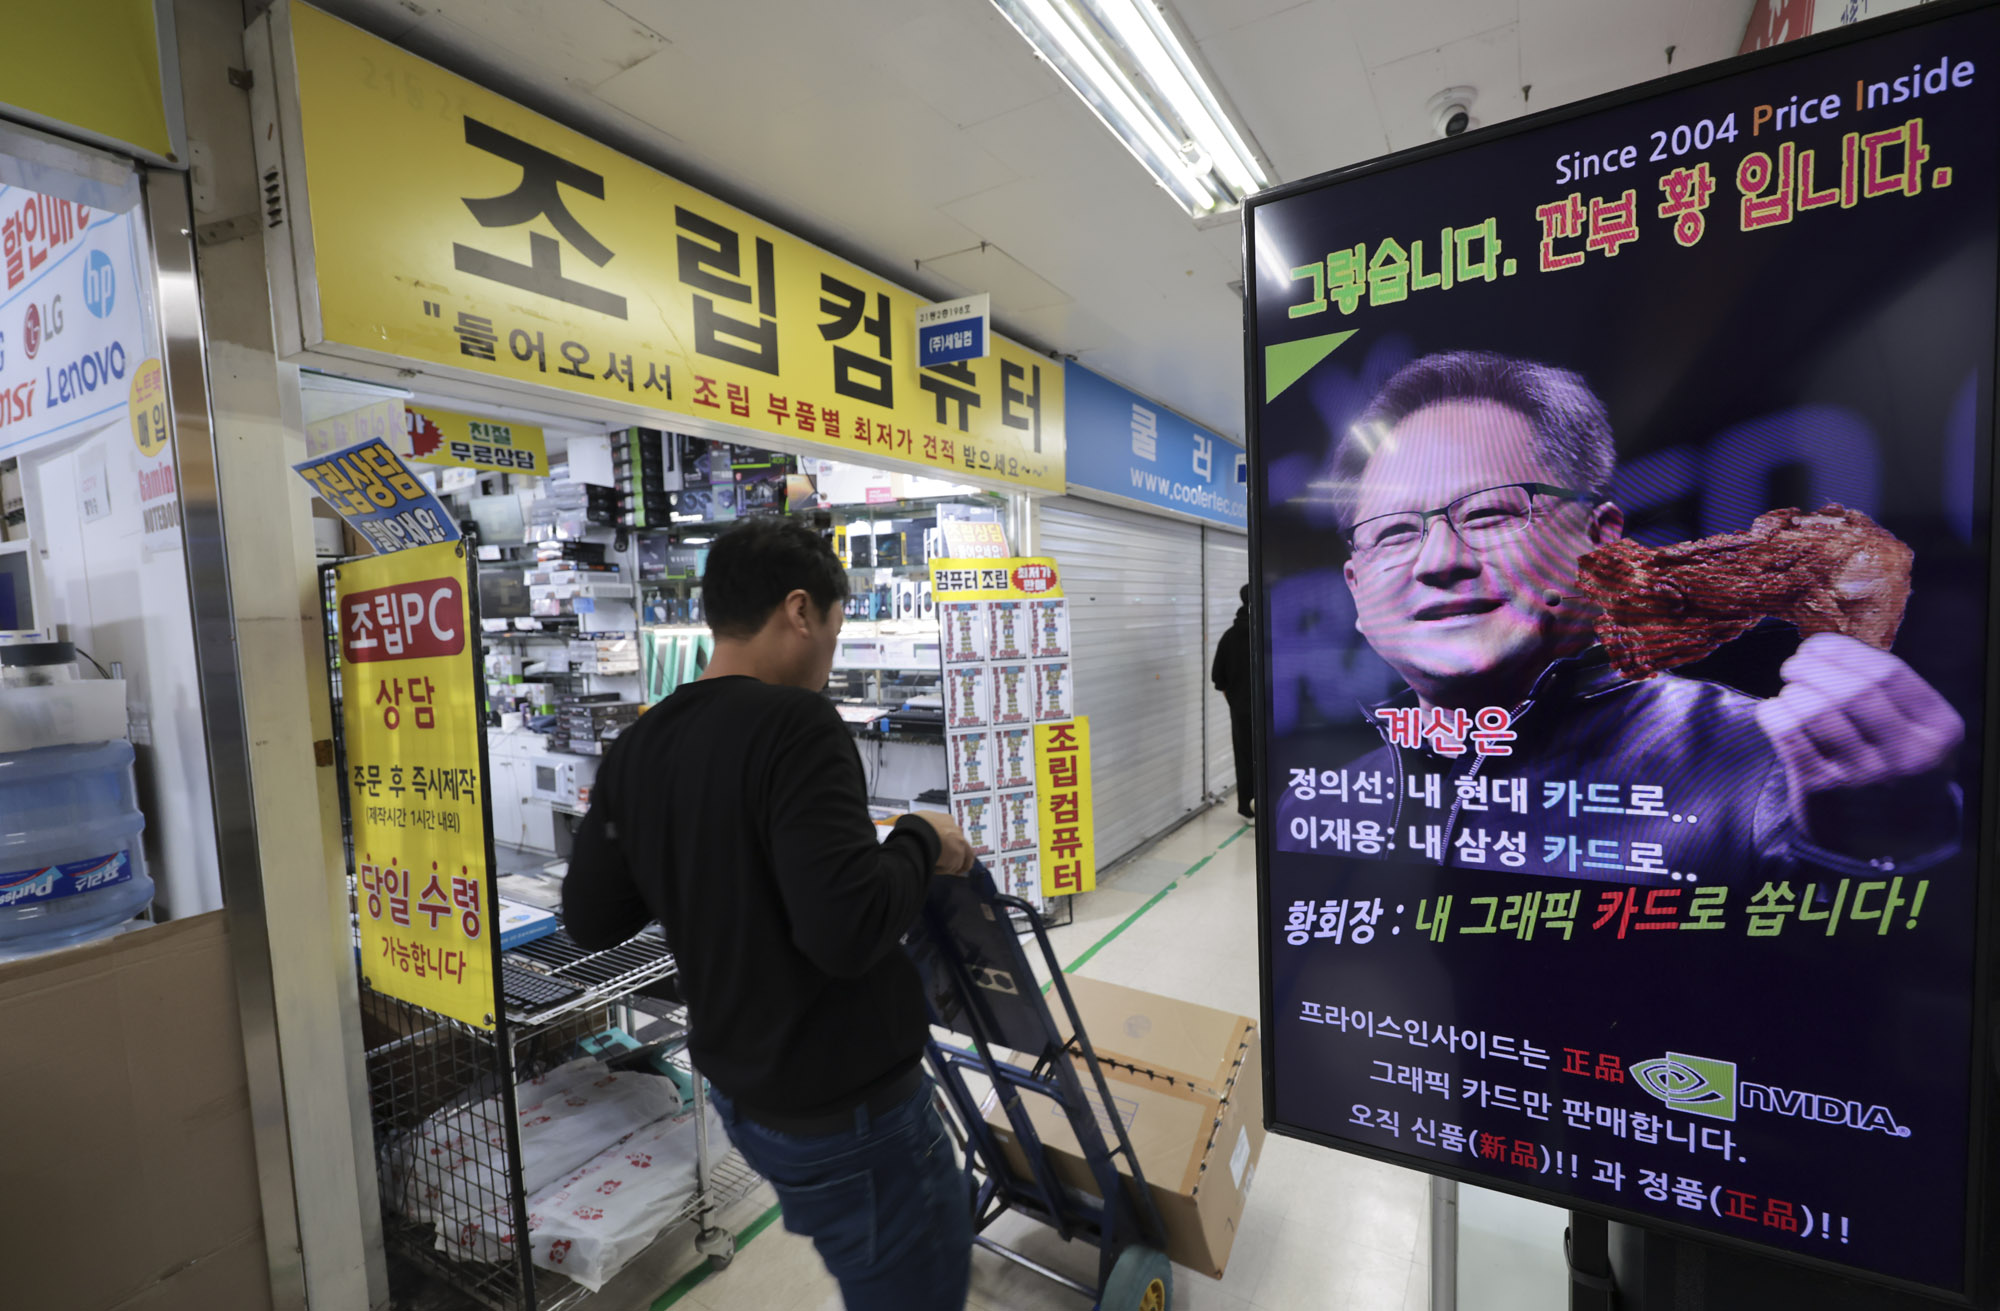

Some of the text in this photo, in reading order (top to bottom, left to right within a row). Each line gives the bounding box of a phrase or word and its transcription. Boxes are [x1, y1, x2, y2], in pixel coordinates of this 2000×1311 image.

[1556, 56, 1976, 185] Since 2004 Price Inside
[1288, 117, 1953, 319] 그렇습니다. 깐부 황 입니다.
[84, 249, 116, 318] hp
[453, 114, 1042, 455] 조립컴퓨터
[43, 294, 64, 341] LG
[693, 375, 750, 418] 조립
[767, 393, 841, 438] 부품별
[854, 416, 912, 455] 최저가
[923, 434, 955, 465] 견적
[300, 443, 426, 516] 조립상담
[450, 441, 535, 470] 무료상담
[1130, 467, 1247, 518] www.coolertec.co
[935, 569, 1008, 591] 컴퓨터 조립
[349, 587, 455, 655] 조립PC
[376, 676, 435, 730] 상담
[1374, 705, 1518, 757] 계산은
[354, 765, 476, 805] 주문 후 즉시제작
[1046, 724, 1083, 892] 조립컴퓨터
[1288, 767, 1396, 805] 정의선:
[1408, 773, 1442, 809] 내
[1454, 774, 1528, 815] 현대
[366, 806, 461, 834] (제작시간 1시간 내외)
[1289, 815, 1396, 855] 이재용:
[1408, 824, 1442, 861] 내
[1454, 826, 1527, 868] 삼성
[360, 853, 481, 940] 당일 수령
[1414, 894, 1454, 943] 내
[1459, 889, 1583, 942] 그래픽
[1592, 886, 1730, 941] 카드로
[1744, 876, 1930, 938] 쏩니다!
[381, 936, 466, 985] 가능합니다
[1299, 1000, 1625, 1085] 프라이스인사이드는 正品
[1369, 1059, 1748, 1163] 그래픽 카드만 판매합니다.
[1348, 1103, 1400, 1138] 오직
[1591, 1158, 1626, 1192] 과
